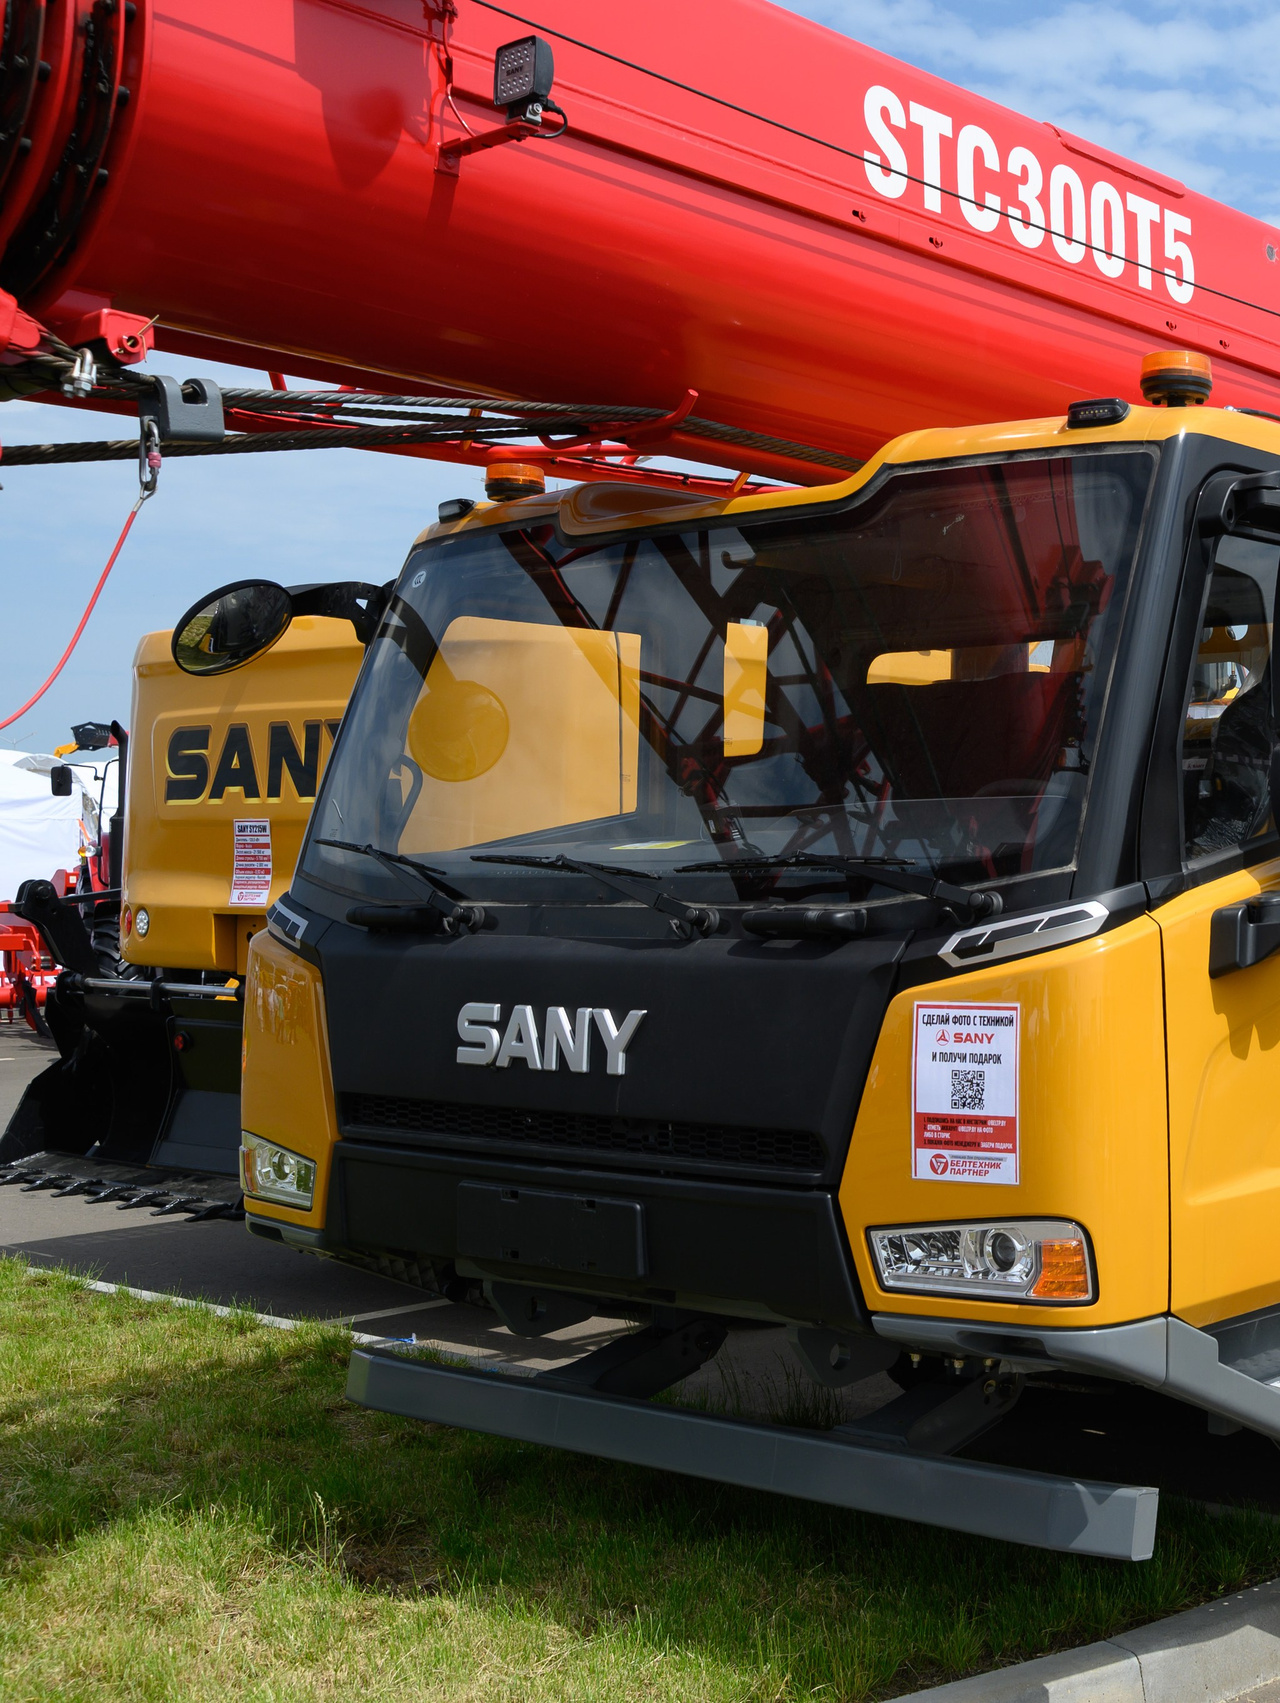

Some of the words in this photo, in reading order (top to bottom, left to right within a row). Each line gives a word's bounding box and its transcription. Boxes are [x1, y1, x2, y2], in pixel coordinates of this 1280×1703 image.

[506, 65, 523, 76] SANY
[864, 86, 1195, 304] STC300T5
[922, 1013, 950, 1026] СДЕЛАЙ
[952, 1015, 971, 1026] ФОТО
[973, 1015, 977, 1026] С
[979, 1014, 1014, 1027] ТЕХНИКОЙ
[456, 1002, 648, 1076] SANY
[953, 1032, 995, 1044] SANY
[932, 1052, 937, 1062] И
[939, 1052, 967, 1063] ПОЛУЧИ
[969, 1053, 1002, 1065] ПОДАРОК
[950, 1160, 1002, 1170] БЕЛТЕХНИК
[950, 1168, 990, 1177] ПАРТНЕР
